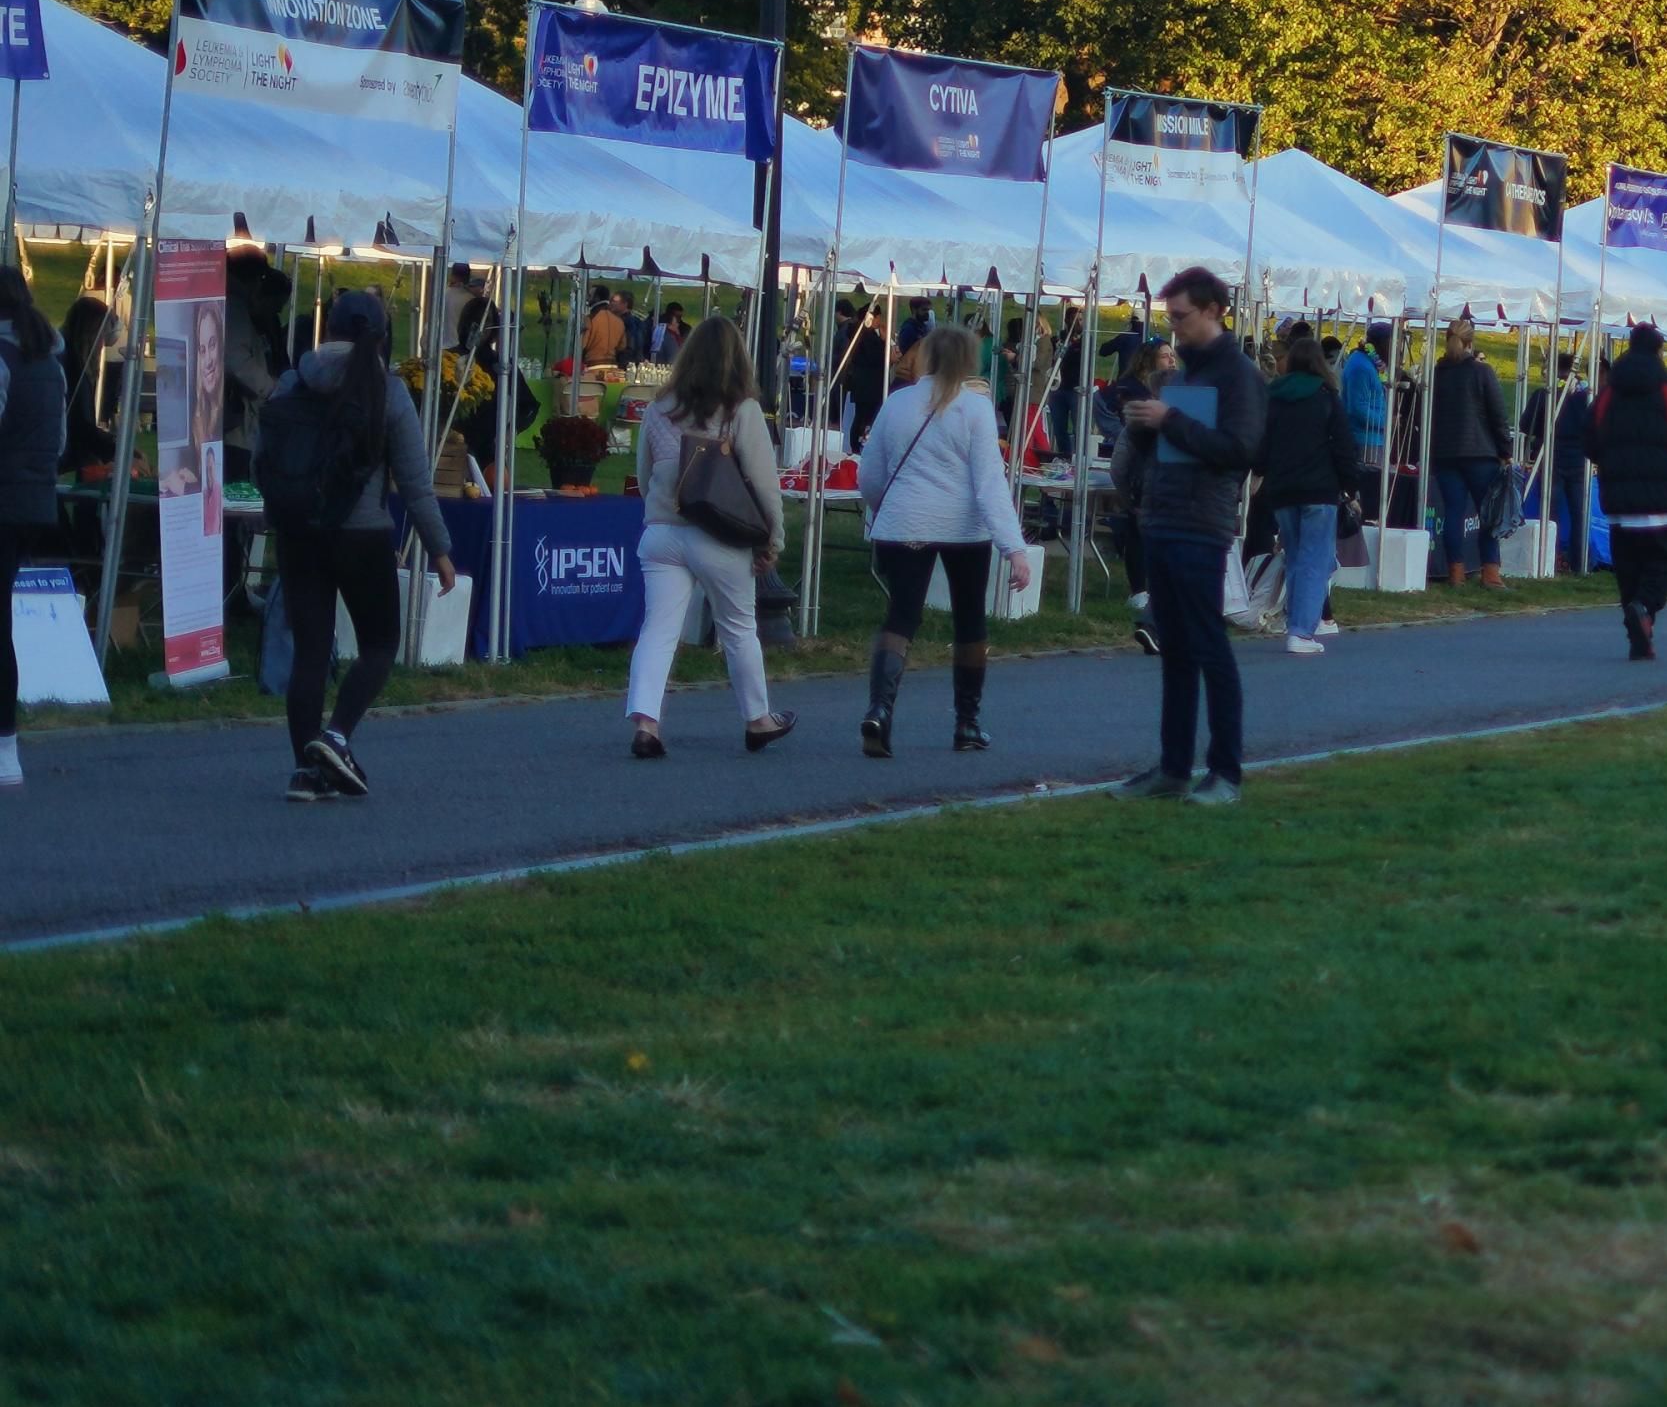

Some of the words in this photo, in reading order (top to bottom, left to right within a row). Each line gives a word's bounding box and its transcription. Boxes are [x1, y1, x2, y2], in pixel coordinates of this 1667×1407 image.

[345, 2, 387, 30] ZONE
[251, 52, 276, 69] LIGHT
[188, 67, 233, 83] SOCIETY
[250, 71, 268, 87] THE
[269, 74, 297, 91] NIGHT
[636, 64, 746, 121] EPIZYME
[929, 83, 979, 116] CYTIVA
[551, 546, 624, 579] IPSEN
[38, 578, 48, 587] to
[551, 583, 580, 595] Innovation
